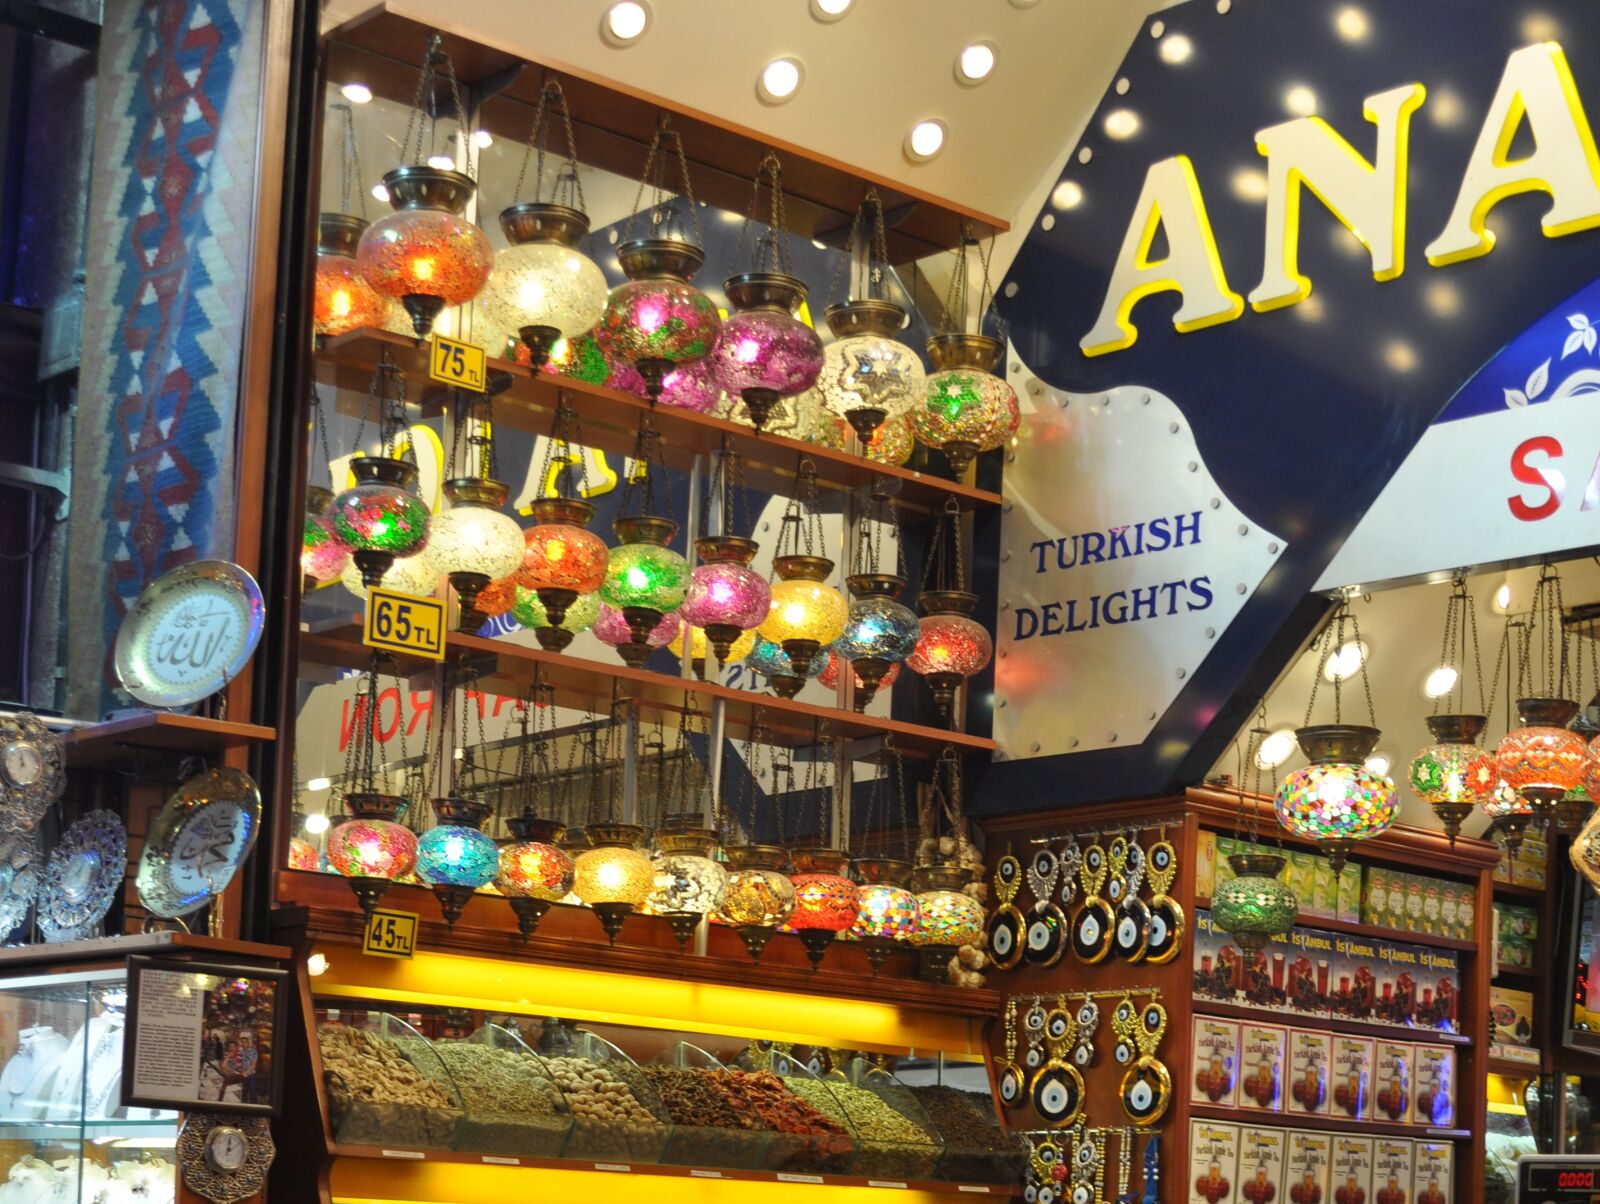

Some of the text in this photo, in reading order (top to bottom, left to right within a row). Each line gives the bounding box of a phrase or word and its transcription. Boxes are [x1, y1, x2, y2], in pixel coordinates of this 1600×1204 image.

[1508, 436, 1600, 522] S
[1029, 510, 1203, 574] TURKISH
[1013, 576, 1214, 641] DELIGHTS
